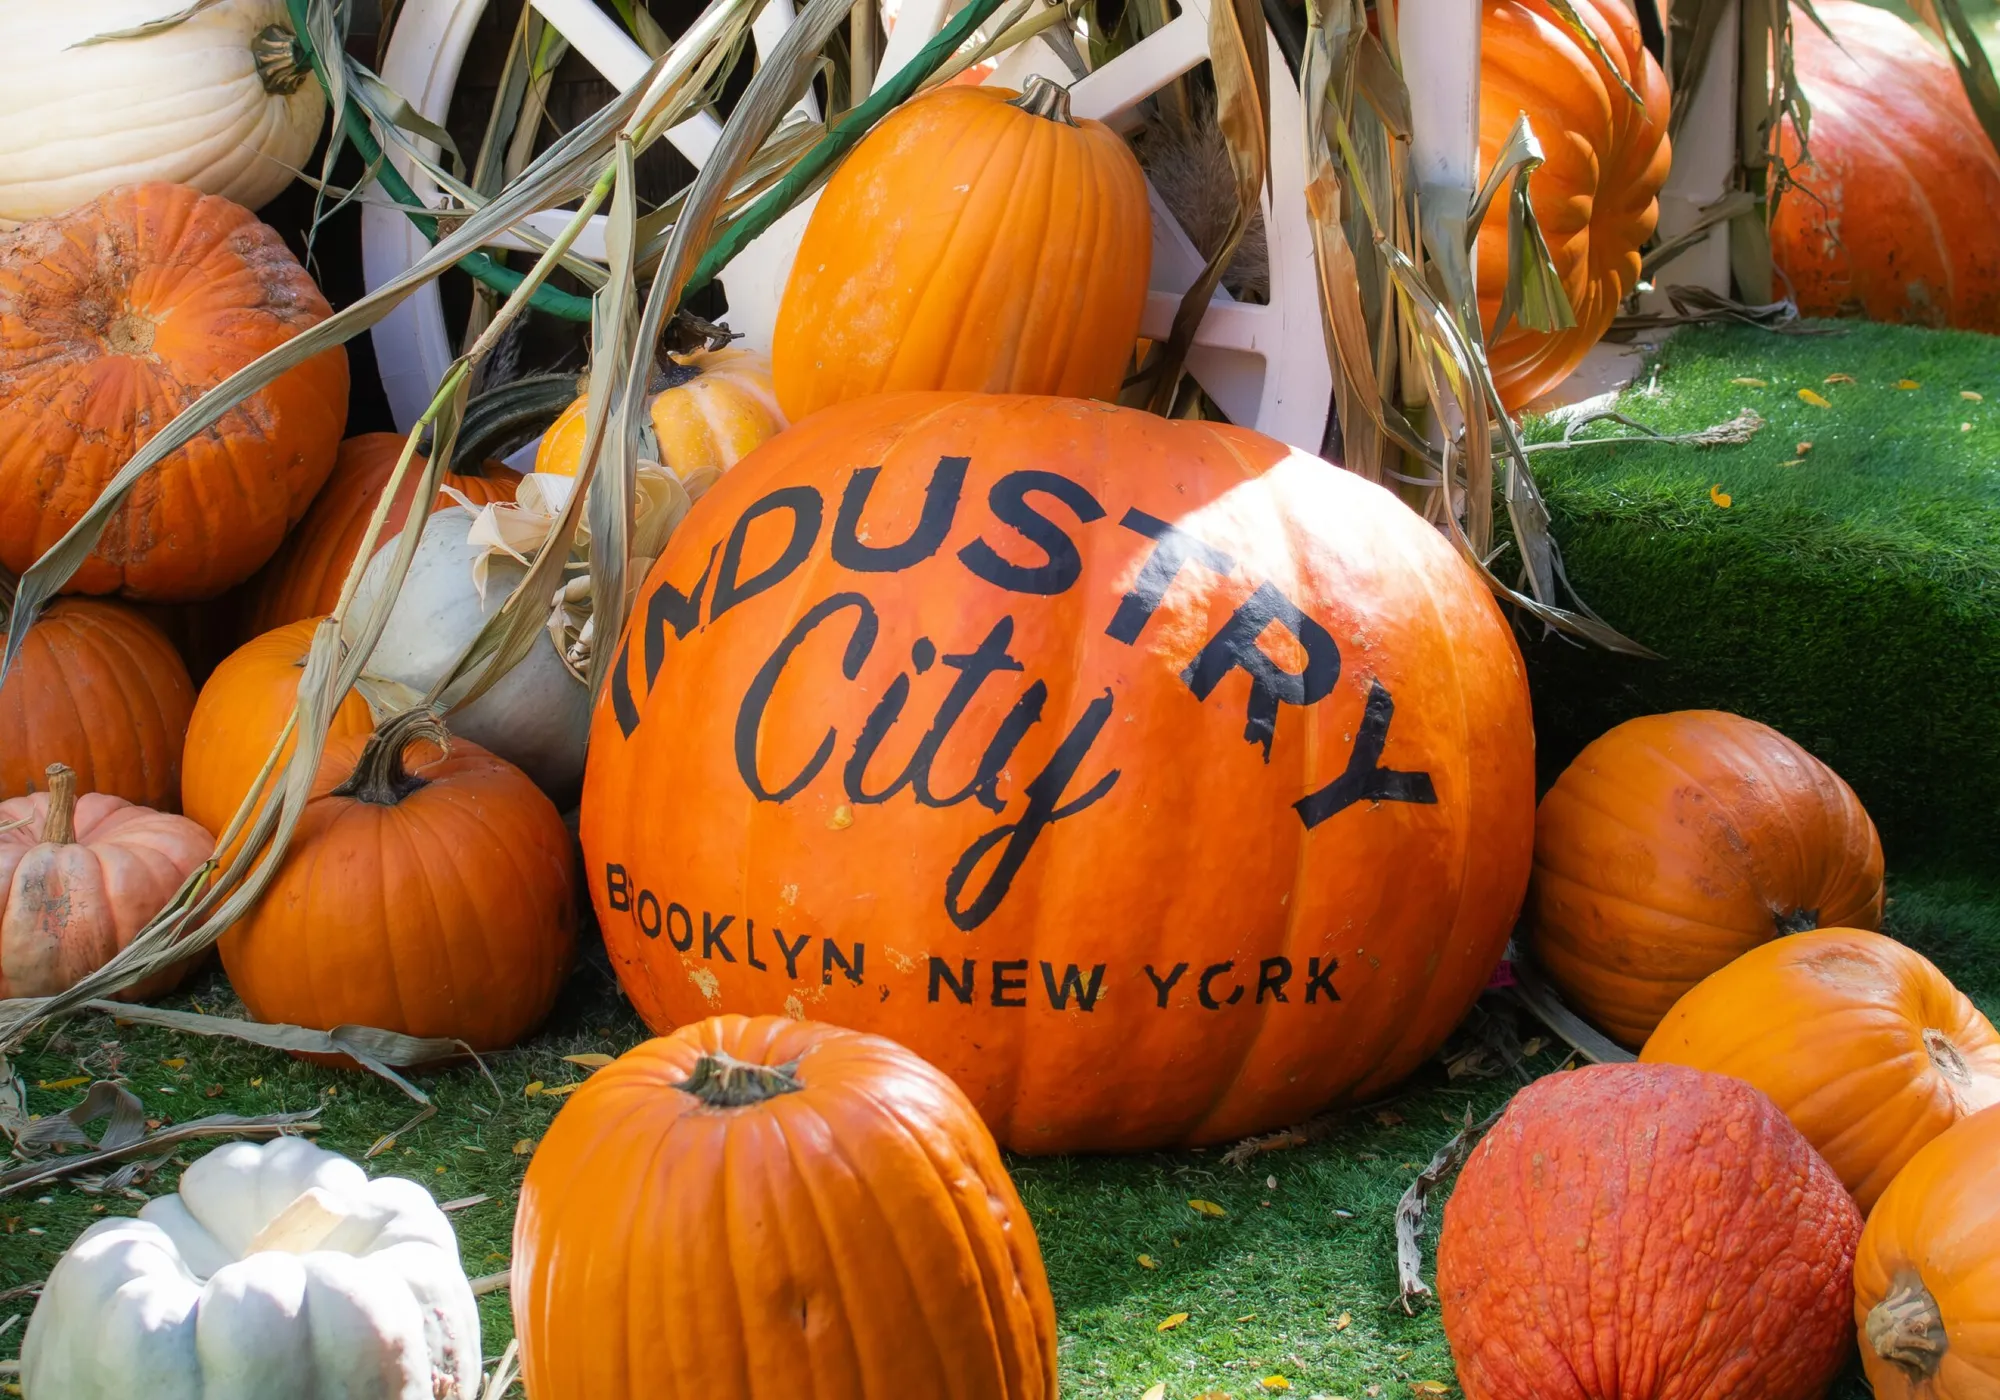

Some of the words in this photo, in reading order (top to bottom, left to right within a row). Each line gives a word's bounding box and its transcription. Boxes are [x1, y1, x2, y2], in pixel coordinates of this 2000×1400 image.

[612, 456, 1438, 830] INDUSTRY
[735, 592, 1121, 931] City
[928, 956, 1107, 1012] NEW
[1144, 956, 1342, 1010] YORK
